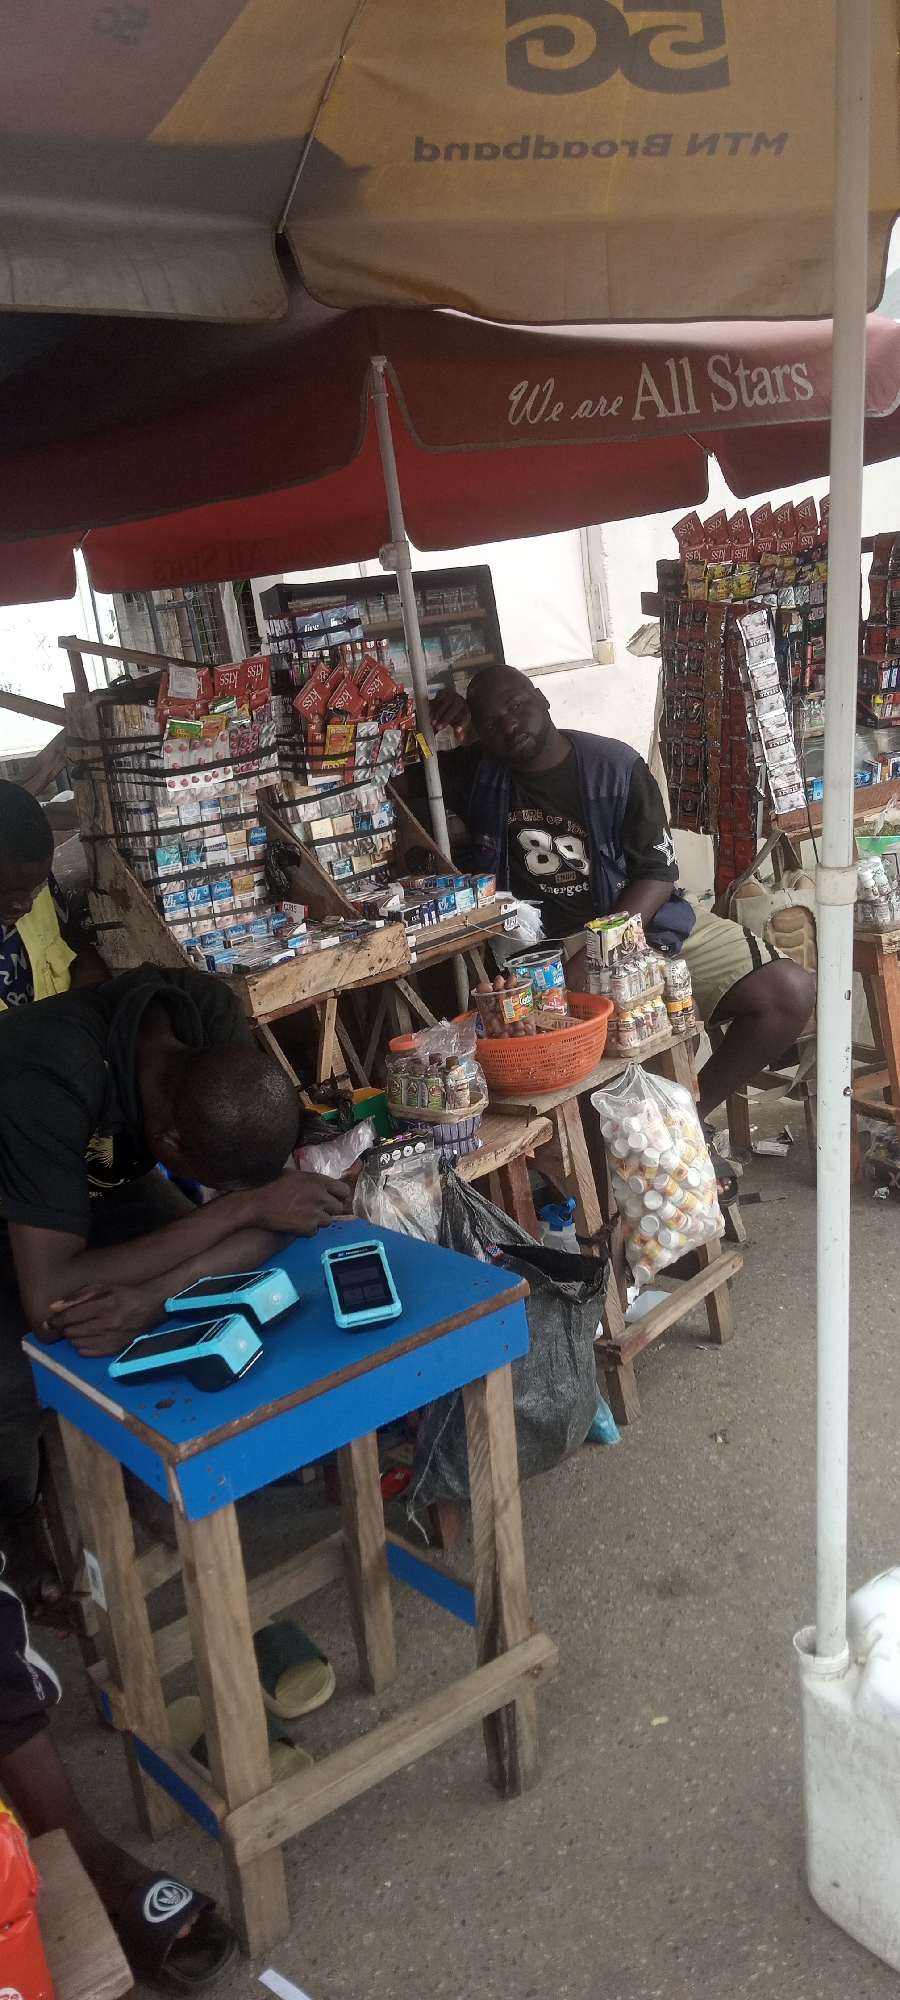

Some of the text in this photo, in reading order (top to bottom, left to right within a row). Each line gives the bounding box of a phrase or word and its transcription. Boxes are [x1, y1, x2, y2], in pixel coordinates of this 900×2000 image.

[507, 353, 814, 426] We are All Stars
[517, 829, 590, 876] 89
